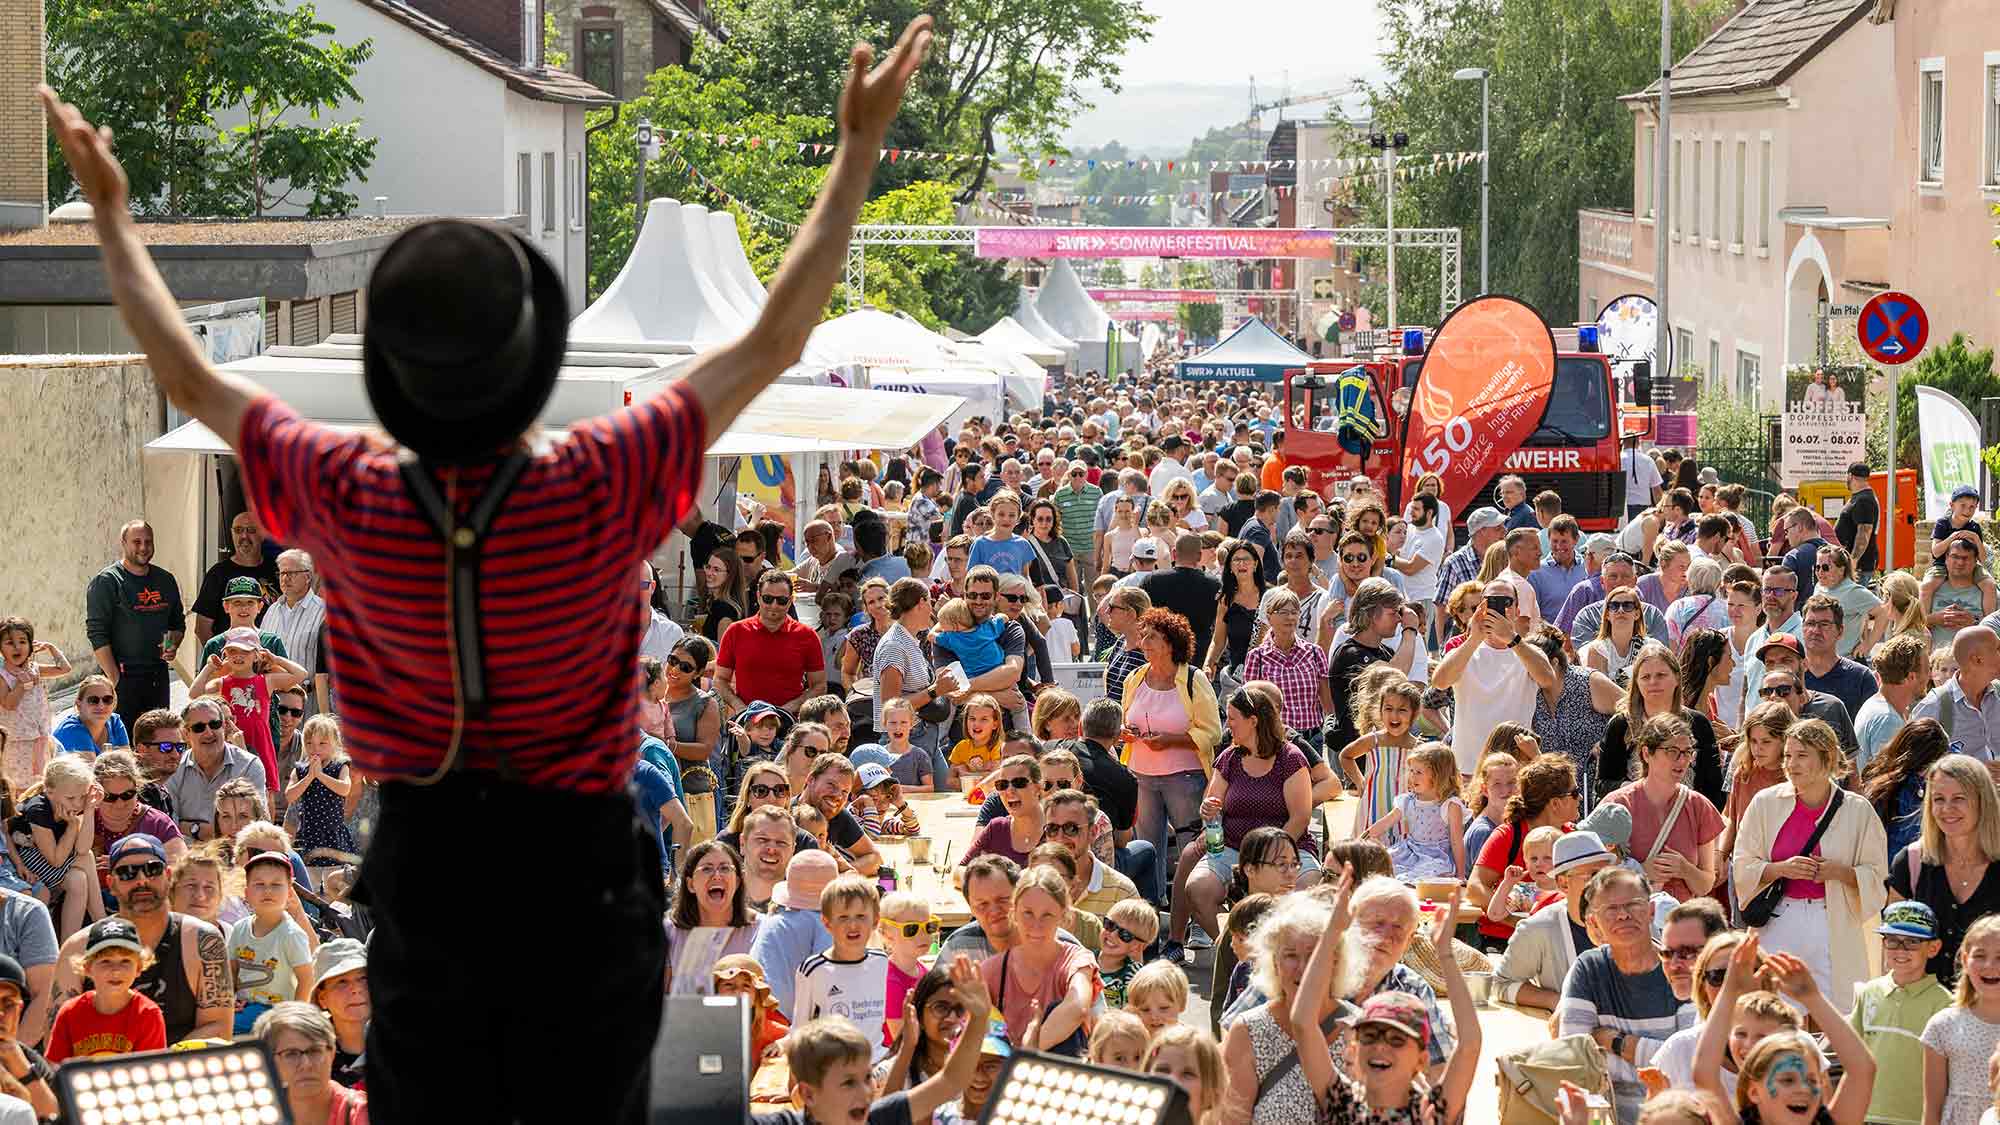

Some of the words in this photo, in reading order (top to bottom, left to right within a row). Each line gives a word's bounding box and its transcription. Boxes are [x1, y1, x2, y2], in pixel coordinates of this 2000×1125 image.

[1111, 235, 1257, 250] SOMMERFESTIVAL
[1830, 305, 1842, 316] Am
[1844, 305, 1860, 316] Pfal
[1215, 367, 1256, 377] AKTUELL
[1468, 360, 1515, 410] Freiwillige
[1476, 364, 1526, 417] Feuerwehr
[1487, 382, 1533, 430] Ingelheim
[1496, 420, 1513, 438] am
[1510, 391, 1538, 421] Rhein
[1790, 400, 1861, 414] HOFFEST
[1410, 415, 1473, 478] 150
[1454, 433, 1489, 479] Jahre
[1789, 434, 1821, 445] 06.07.
[1831, 435, 1861, 445] 08.07.
